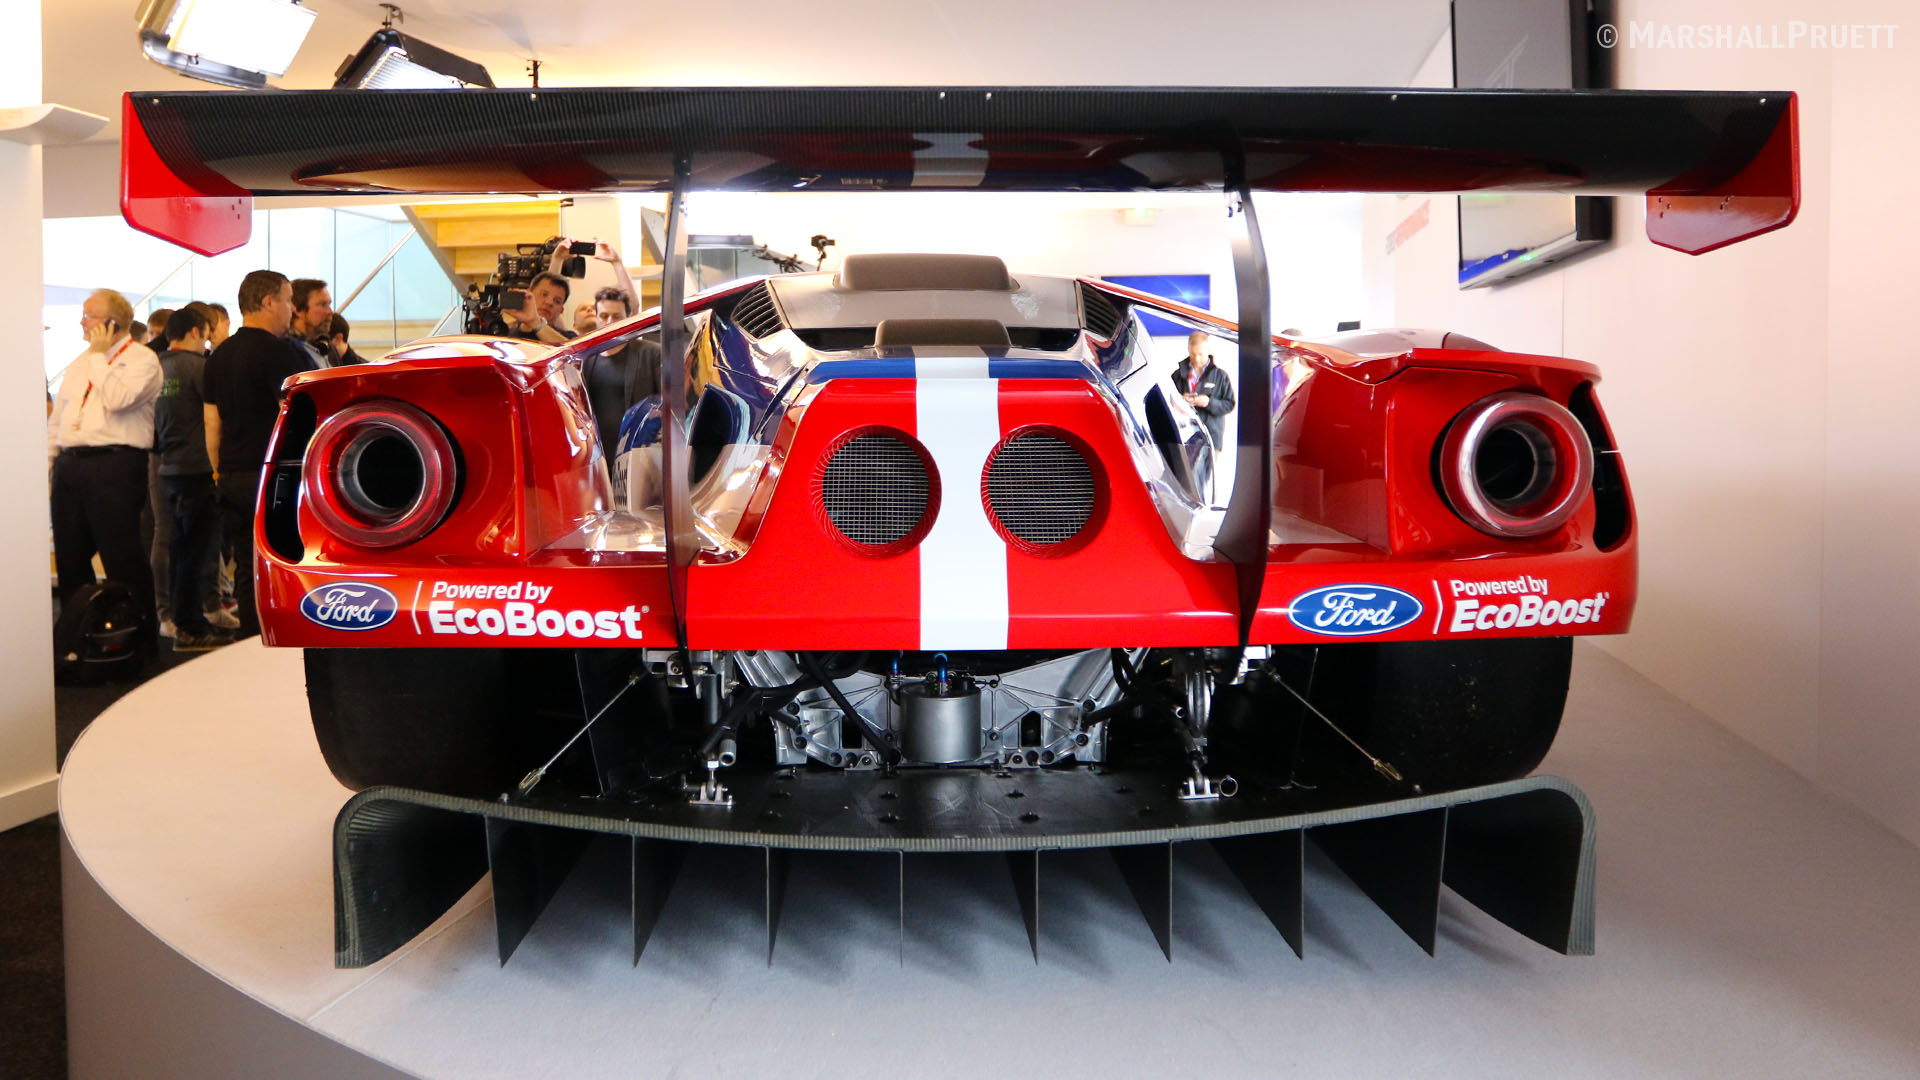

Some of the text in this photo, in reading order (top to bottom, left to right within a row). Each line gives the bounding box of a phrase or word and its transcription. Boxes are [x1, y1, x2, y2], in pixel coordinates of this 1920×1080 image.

[431, 582, 553, 603] Powered by
[1451, 575, 1549, 597] Powered by
[316, 588, 376, 622] Ford
[1315, 591, 1397, 627] Ford
